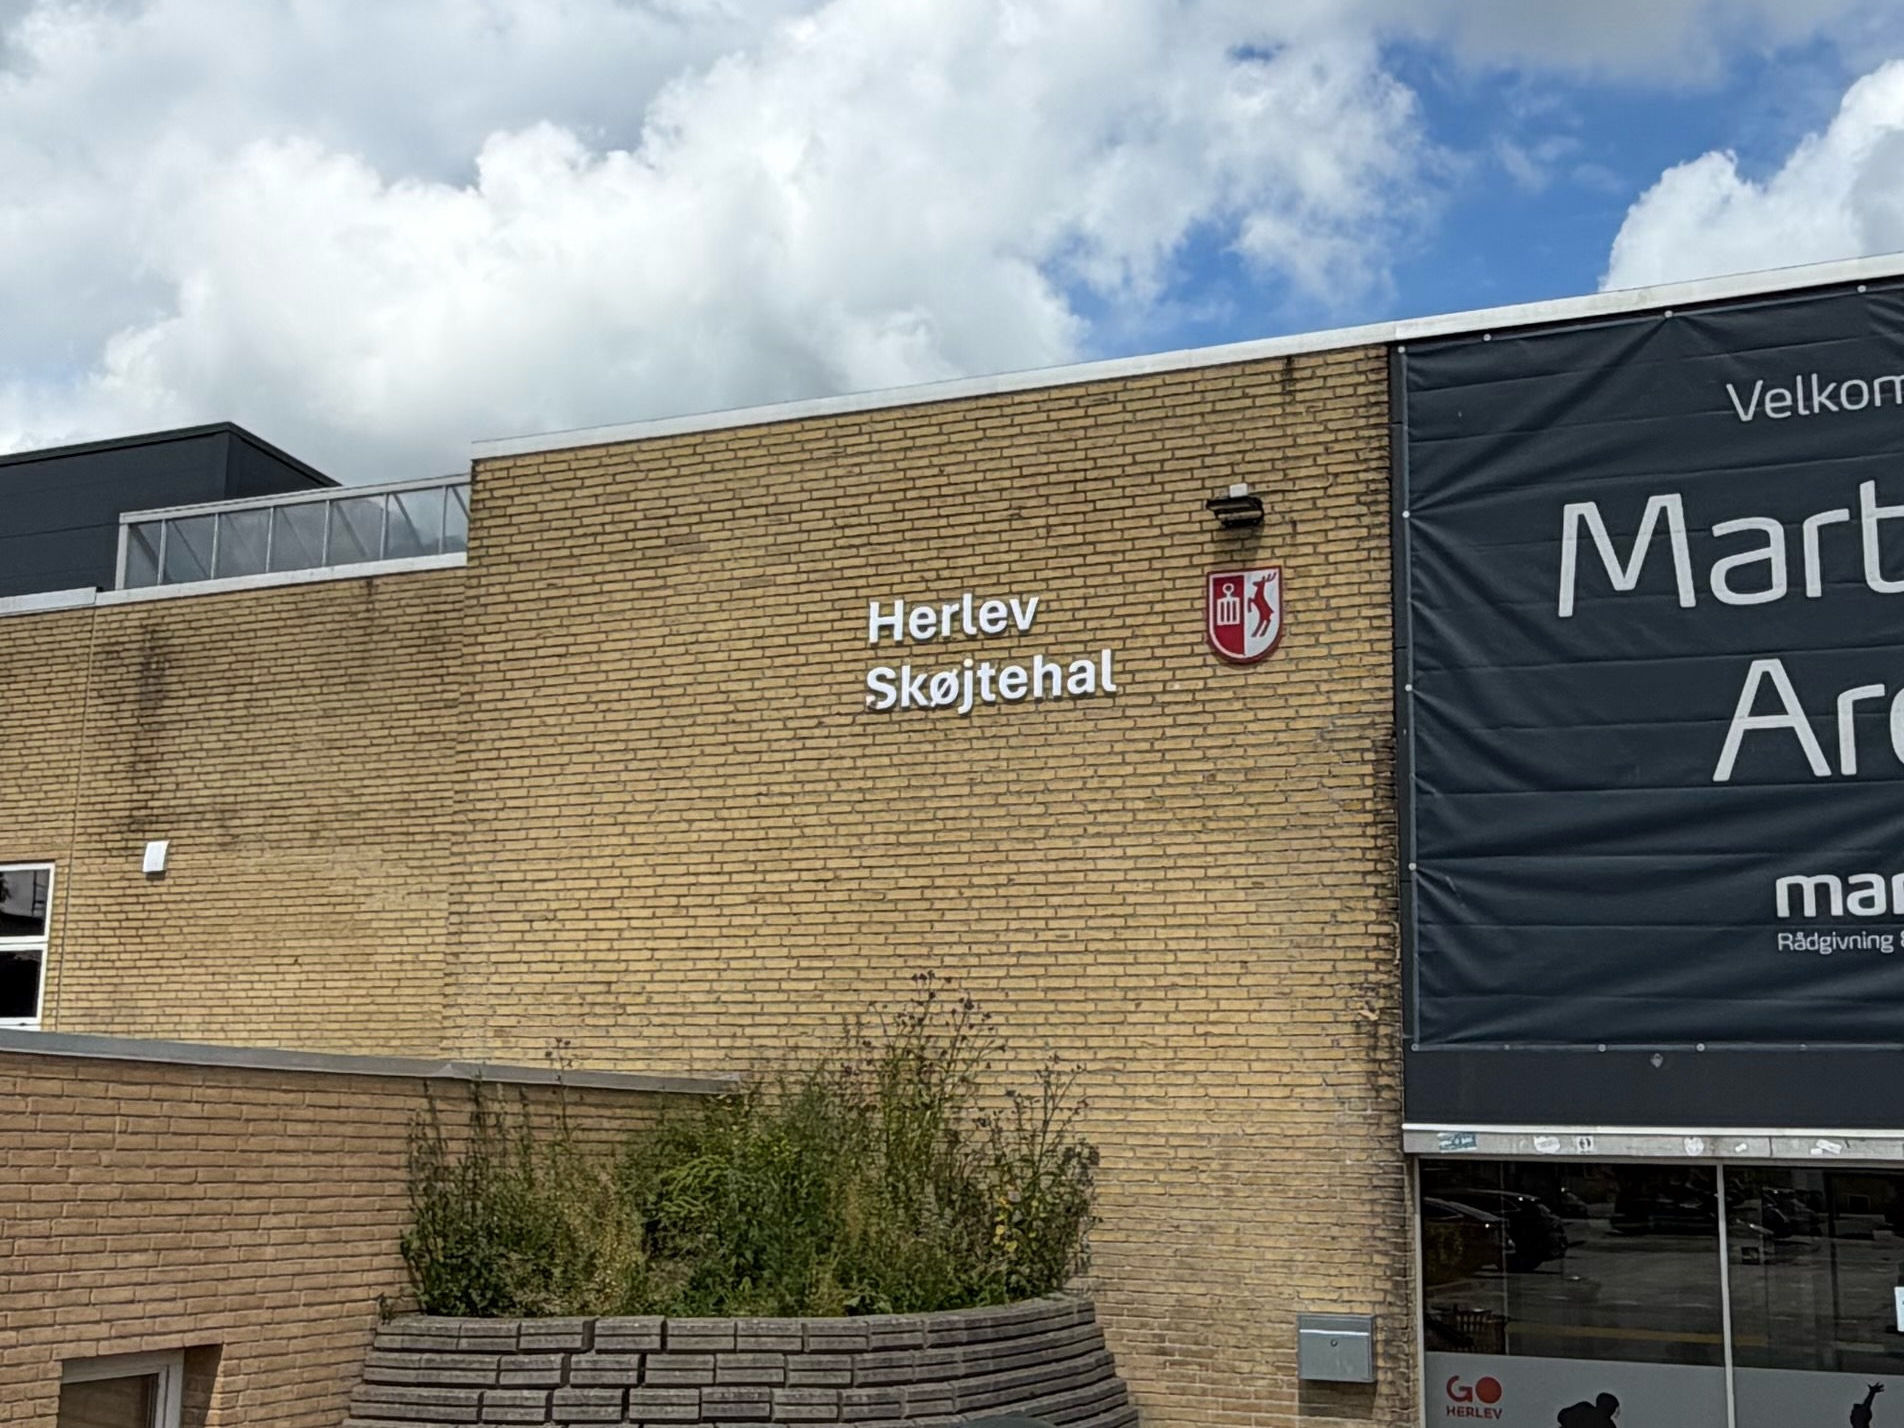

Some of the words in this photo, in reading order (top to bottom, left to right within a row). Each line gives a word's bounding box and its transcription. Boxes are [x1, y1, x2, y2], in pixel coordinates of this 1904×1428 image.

[868, 593, 1039, 644] Herlev
[866, 648, 1117, 715] Skøjtehal
[1777, 931, 1894, 954] Rådgivning
[1446, 1375, 1503, 1404] GO
[1446, 1405, 1503, 1420] HERLEV
